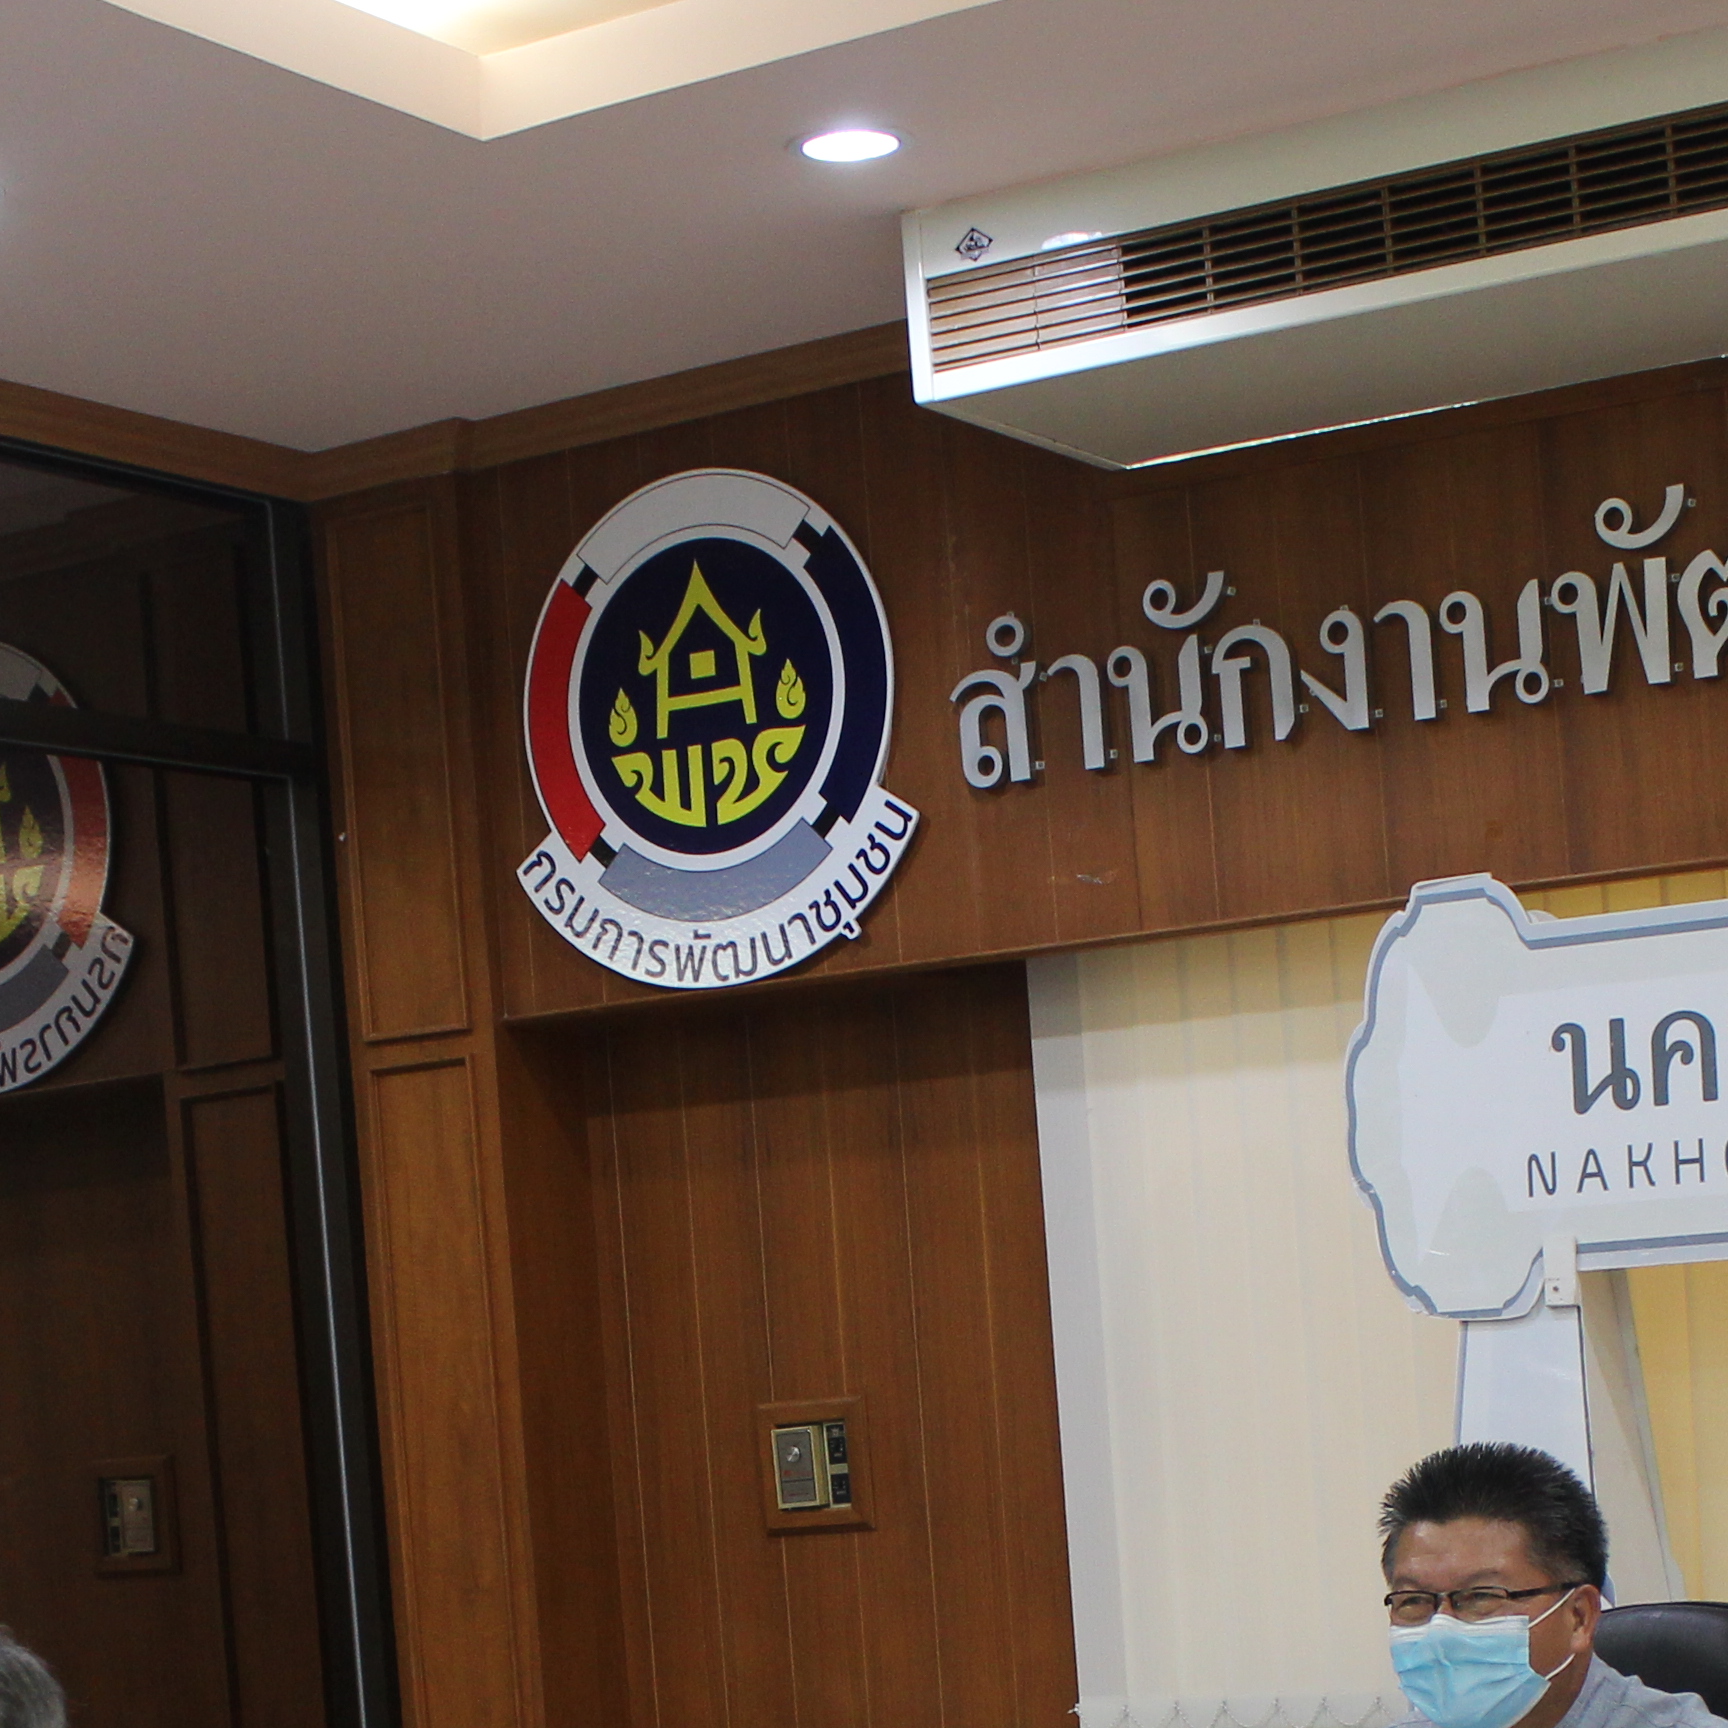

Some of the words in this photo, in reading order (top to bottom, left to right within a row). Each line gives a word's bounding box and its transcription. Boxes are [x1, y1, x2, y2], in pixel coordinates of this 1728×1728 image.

[521, 798, 915, 983] กรมการพัฒนาชุมชน
